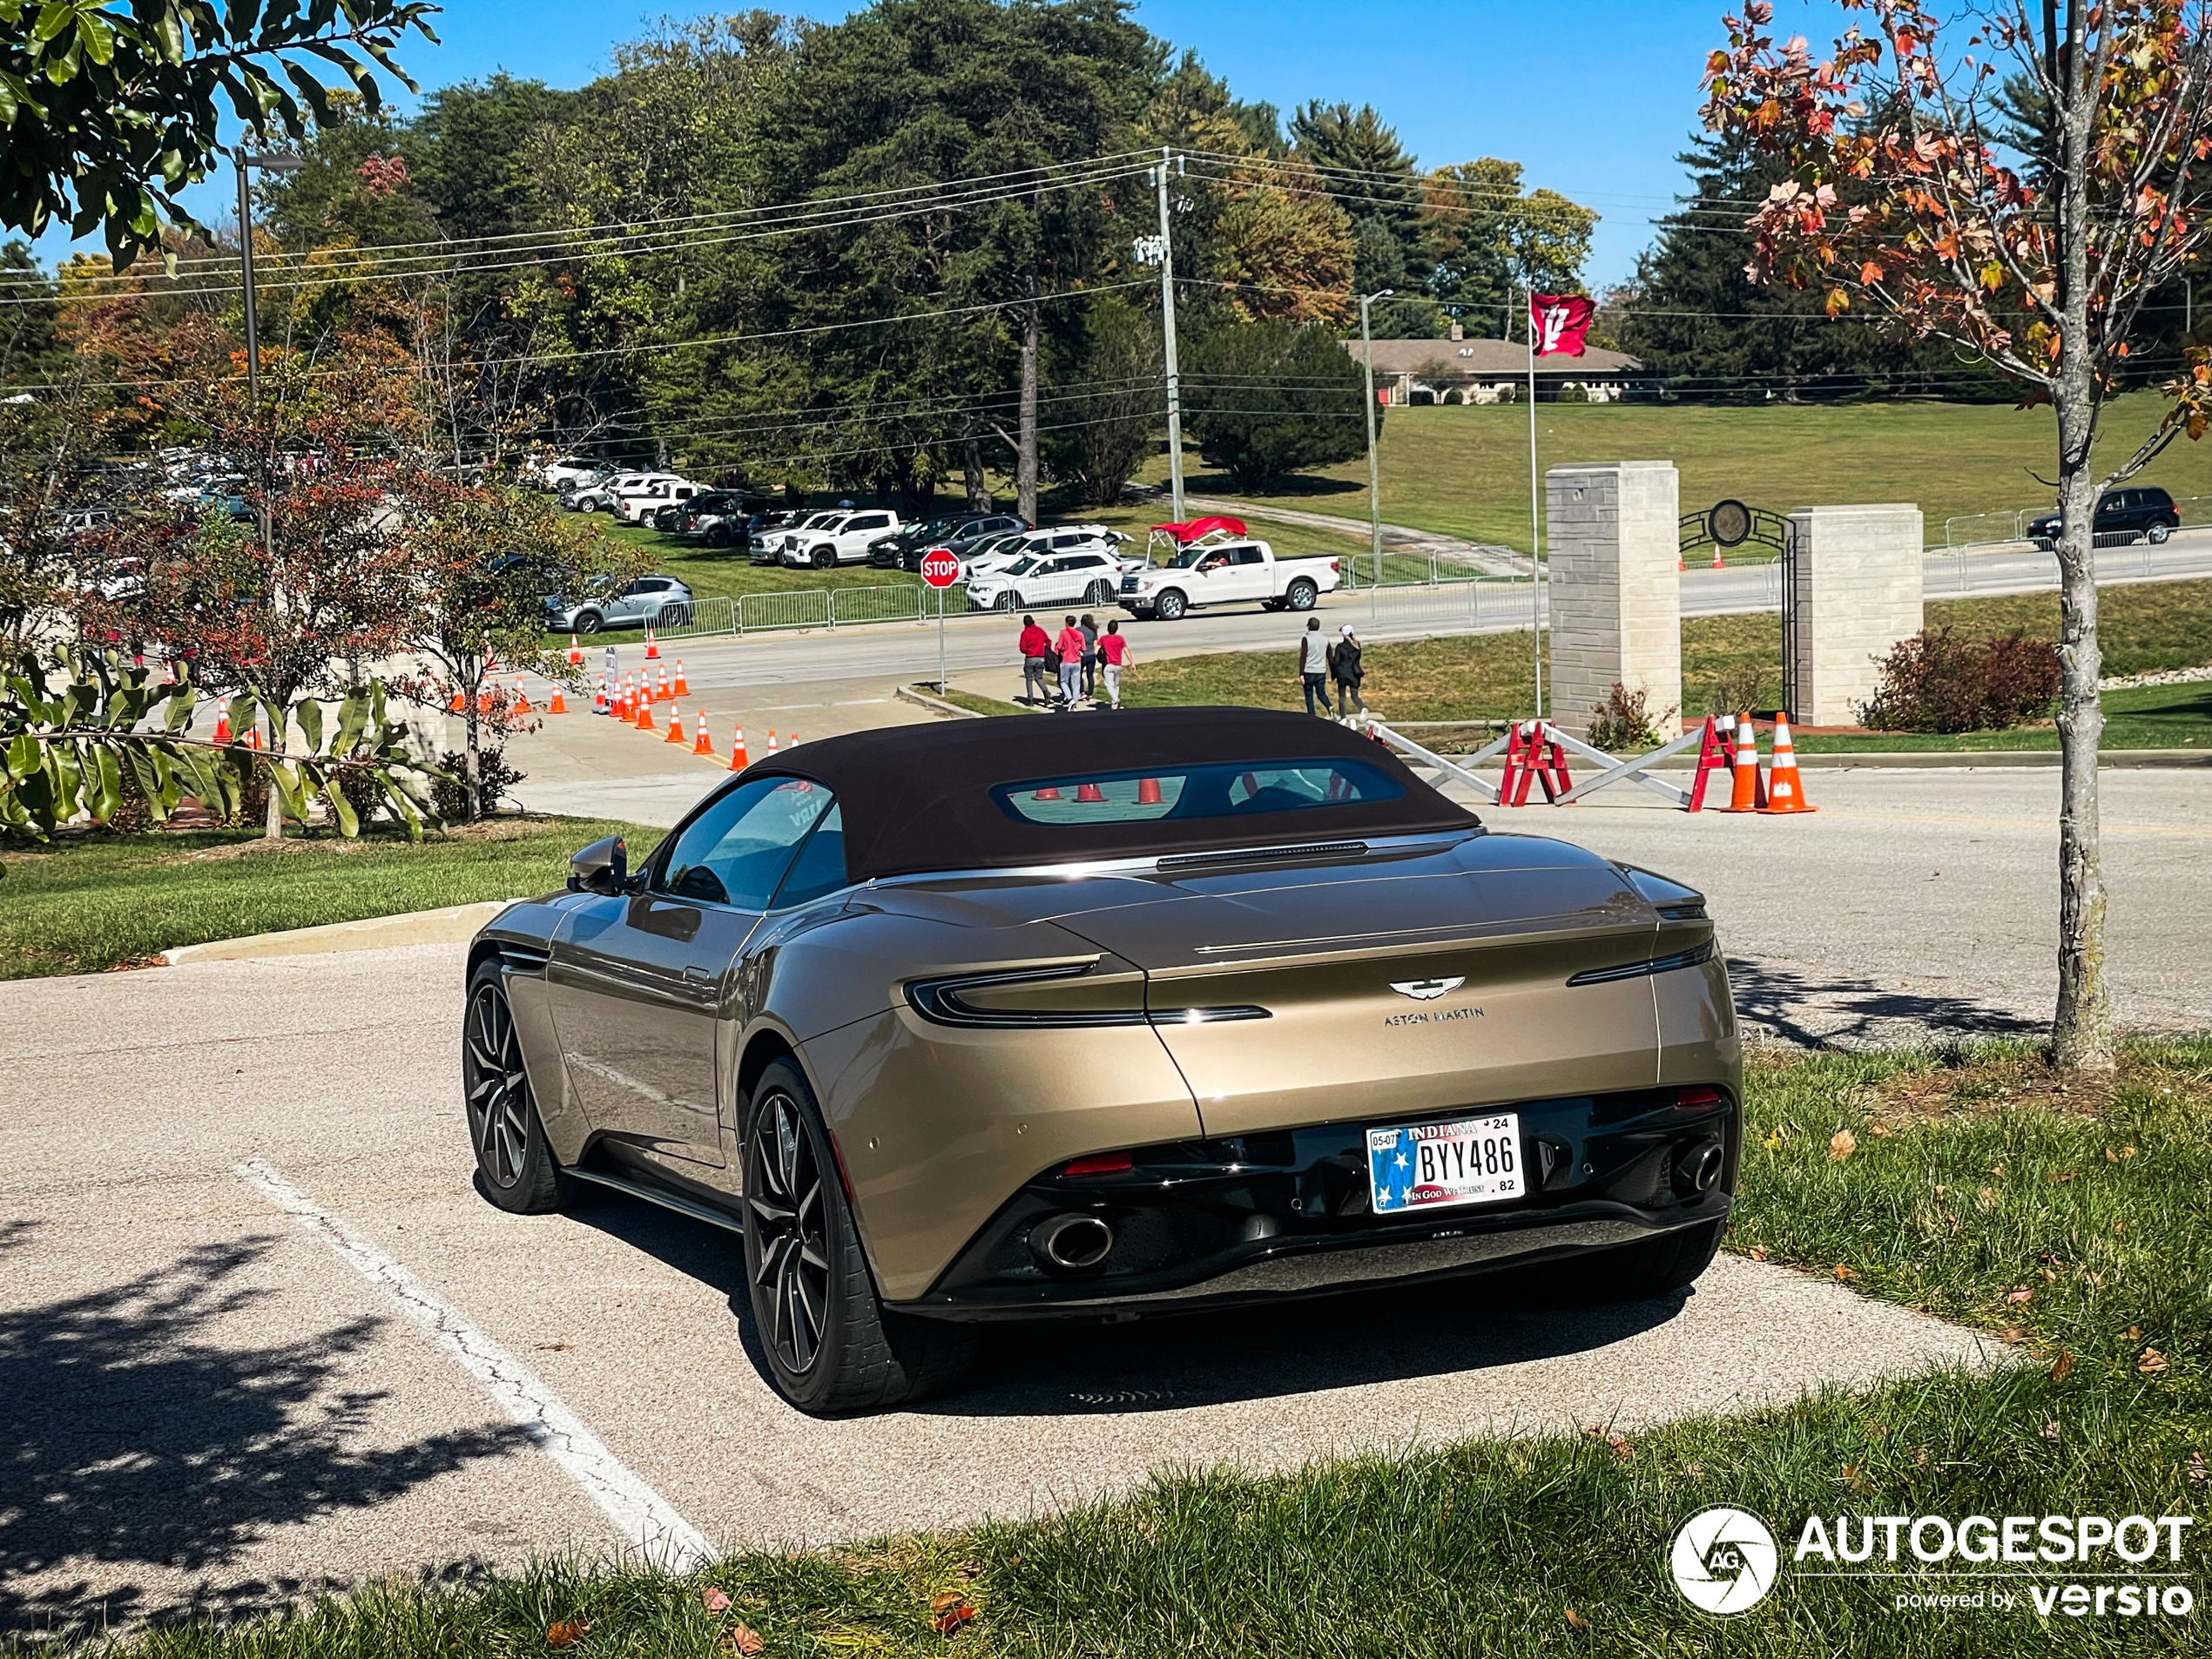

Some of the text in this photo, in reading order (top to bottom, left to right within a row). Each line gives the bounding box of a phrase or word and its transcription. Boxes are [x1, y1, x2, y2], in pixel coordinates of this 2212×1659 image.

[924, 561, 957, 577] STOP
[1385, 1007, 1485, 1027] ASTON MARTIN
[1408, 1121, 1478, 1141] INDIANA
[1493, 1118, 1509, 1130] 24
[1372, 1134, 1395, 1146] 05-07
[1420, 1136, 1514, 1183] BYY486
[1500, 1180, 1514, 1190] 82
